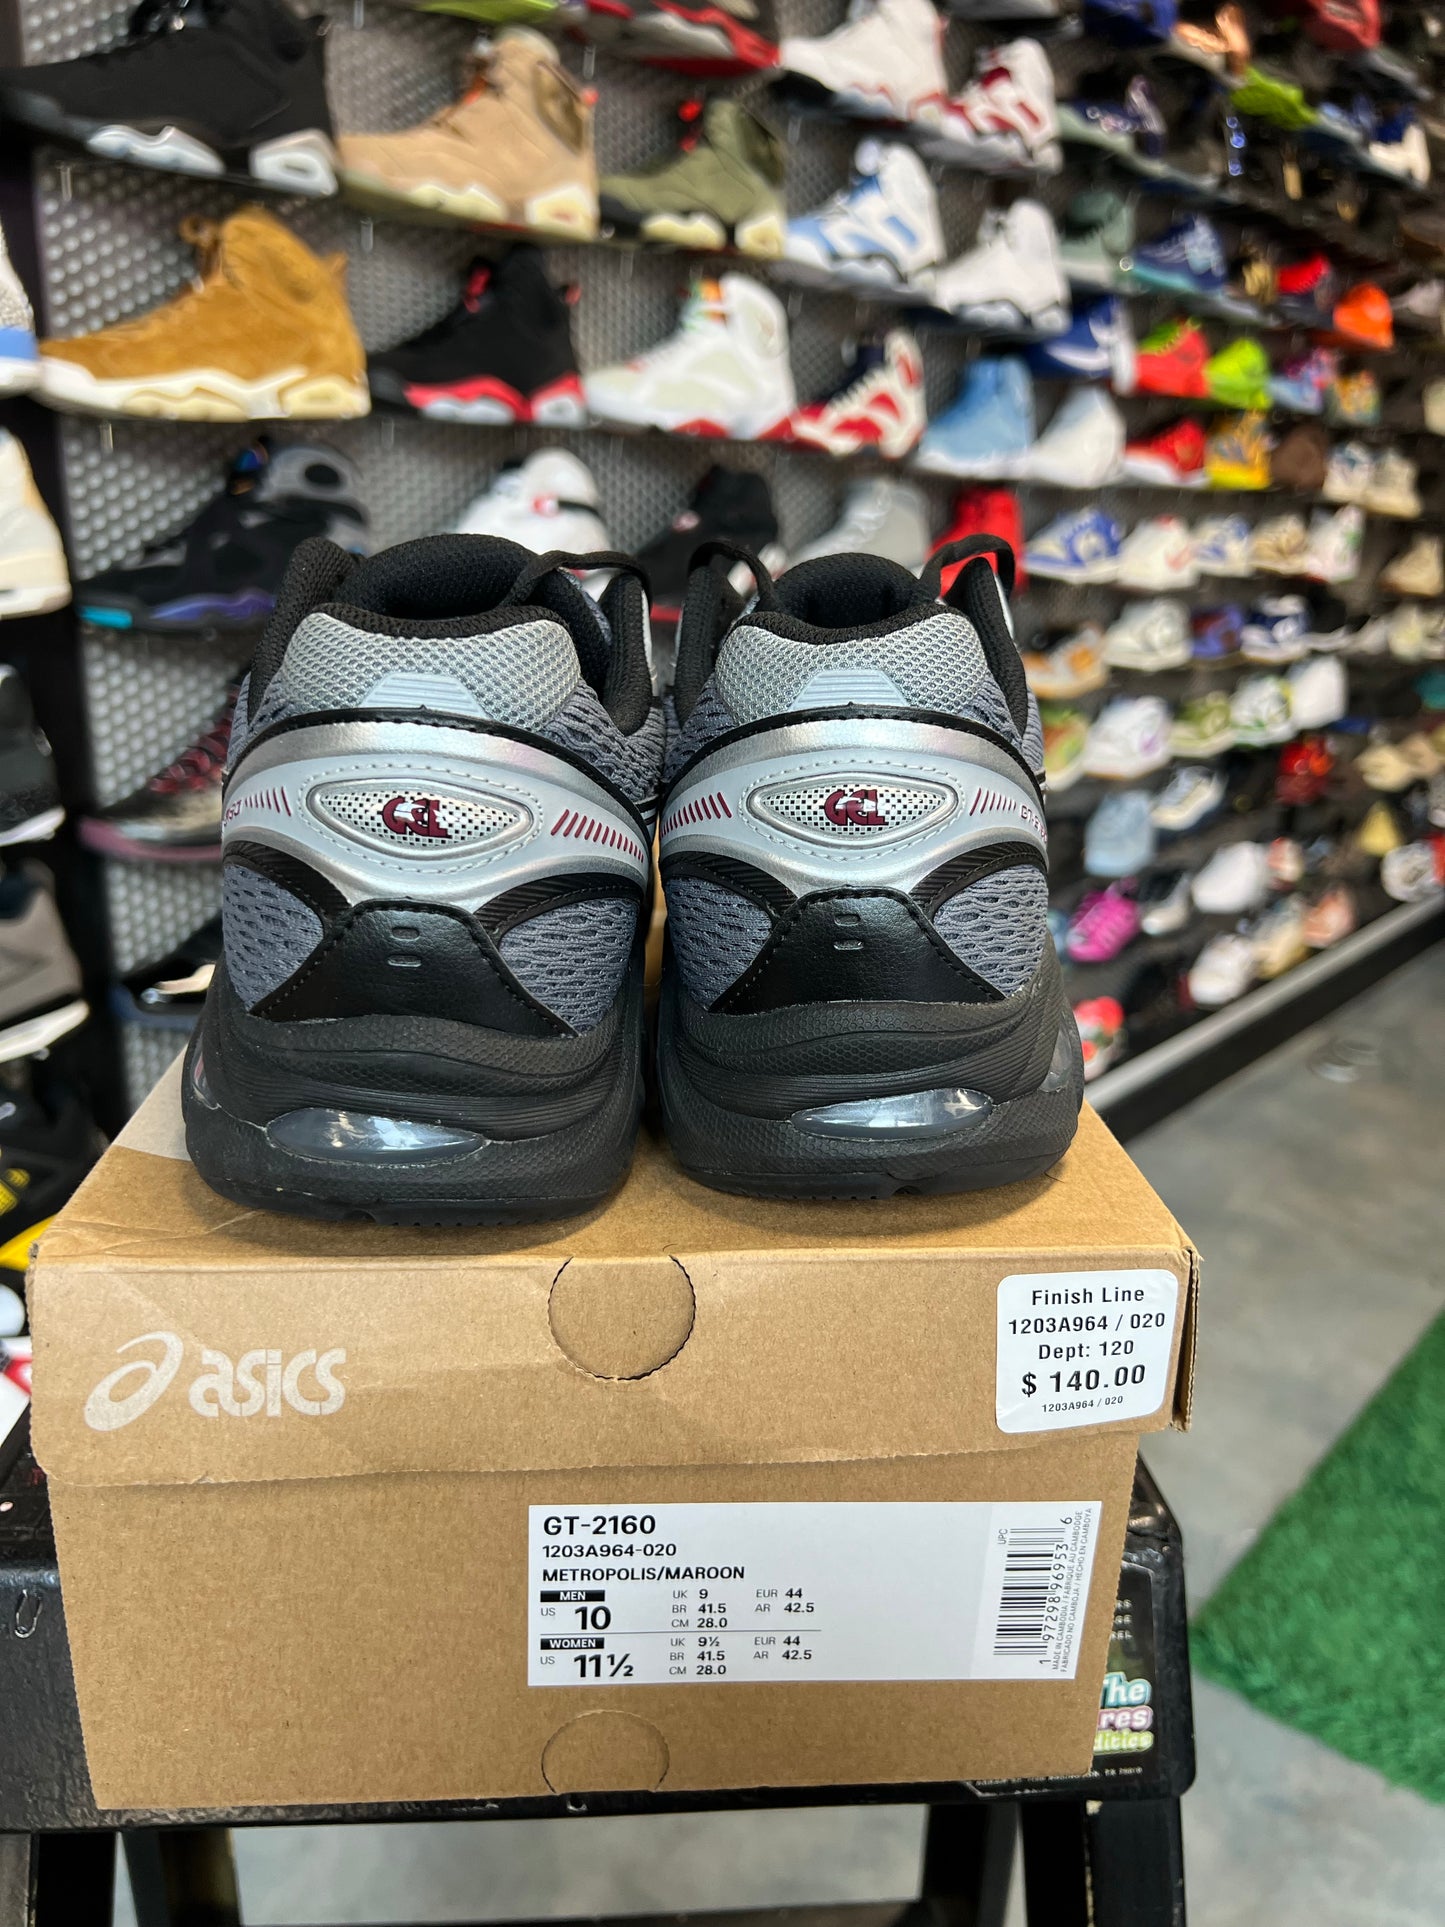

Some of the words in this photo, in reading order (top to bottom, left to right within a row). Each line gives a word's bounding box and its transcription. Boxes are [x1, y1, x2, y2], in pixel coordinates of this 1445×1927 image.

[1032, 1288, 1093, 1306] Finish
[1102, 1287, 1145, 1303] Line
[1008, 1315, 1108, 1335] 1203A964
[1130, 1312, 1165, 1329] 020
[1038, 1343, 1090, 1361] Dept:
[1099, 1340, 1134, 1356] 120
[188, 1348, 347, 1417] asics
[1021, 1371, 1037, 1397] $
[1049, 1364, 1146, 1392] 140.00
[1041, 1399, 1094, 1413] 1203A964
[1104, 1395, 1123, 1406] 020
[543, 1514, 656, 1535] GT-2160
[1069, 1511, 1083, 1552] CAMBODGE
[1080, 1508, 1092, 1544] CAMBOYA
[997, 1529, 1008, 1545] UPC
[542, 1543, 677, 1558] 1203A964-020
[1068, 1553, 1077, 1563] AU
[1077, 1545, 1087, 1555] EN
[542, 1566, 745, 1582] METROPOLIS/MAROON
[1075, 1556, 1086, 1581] HECHO
[1063, 1565, 1076, 1599] FABRIQUE
[560, 1591, 586, 1601] MEN
[672, 1589, 688, 1599] UK
[699, 1588, 708, 1600] 9
[756, 1589, 778, 1598] EUR
[785, 1587, 803, 1599] 44
[672, 1604, 687, 1613] BR
[698, 1602, 726, 1614] 41.5
[755, 1603, 770, 1612] AR
[784, 1602, 815, 1613] 42.5
[1067, 1587, 1080, 1621] CAMBOJA
[540, 1607, 556, 1616] US
[575, 1605, 611, 1630] 10
[671, 1619, 689, 1628] CM
[697, 1617, 727, 1628] 28.0
[1057, 1605, 1068, 1641] CAMBODIA
[1065, 1622, 1074, 1633] NO
[549, 1639, 596, 1649] WOMEN
[670, 1637, 685, 1646] UK
[754, 1636, 776, 1645] EUR
[783, 1635, 801, 1646] 44
[540, 1656, 556, 1665] US
[669, 1652, 685, 1661] BR
[696, 1650, 725, 1661] 41.5
[753, 1650, 769, 1659] AR
[782, 1649, 812, 1660] 42.5
[1052, 1651, 1062, 1670] MADE
[1060, 1634, 1073, 1672] FABRICADO
[669, 1666, 687, 1675] CM
[696, 1664, 726, 1675] 28.0
